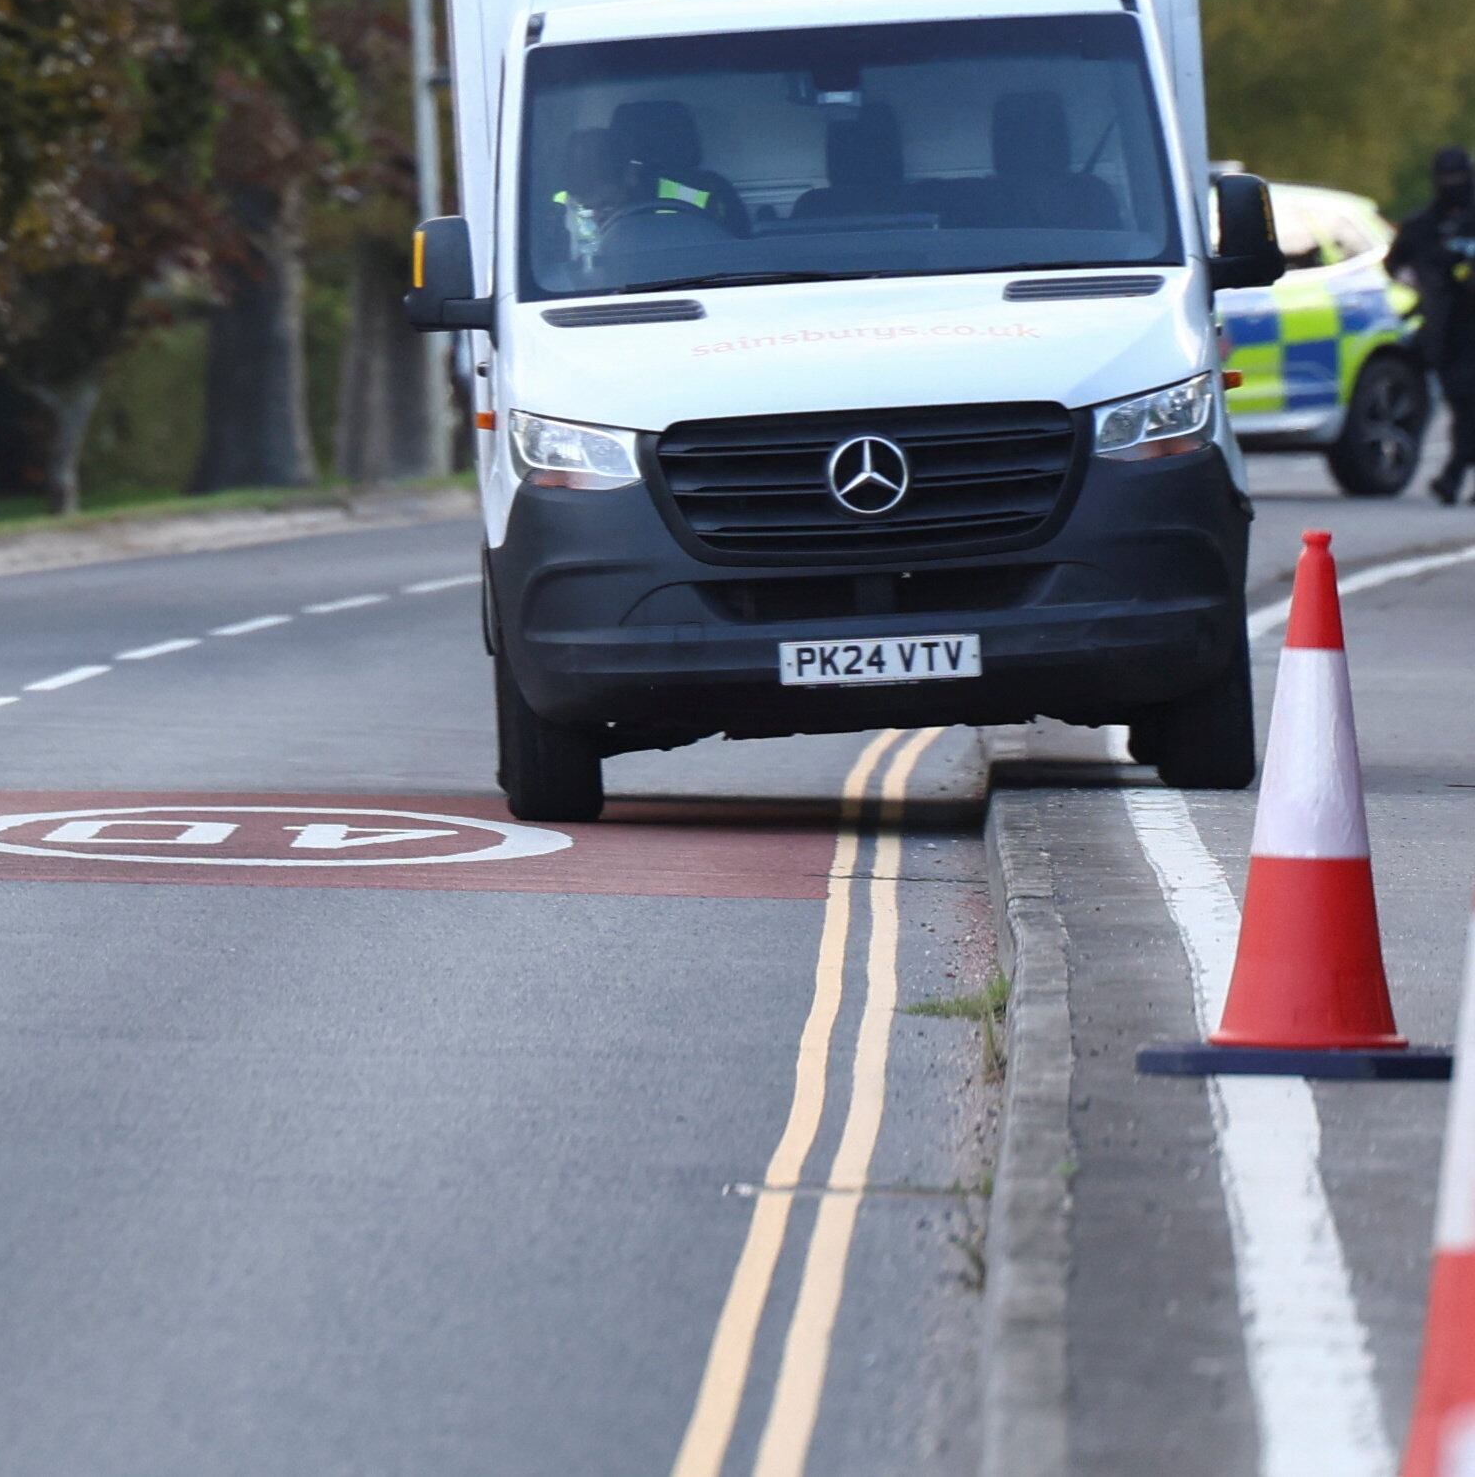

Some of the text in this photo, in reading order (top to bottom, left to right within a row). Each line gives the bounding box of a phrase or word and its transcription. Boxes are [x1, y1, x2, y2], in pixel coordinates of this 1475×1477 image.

[691, 323, 1041, 358] sainsburys.co.uk
[796, 640, 964, 678] PK24 VTV
